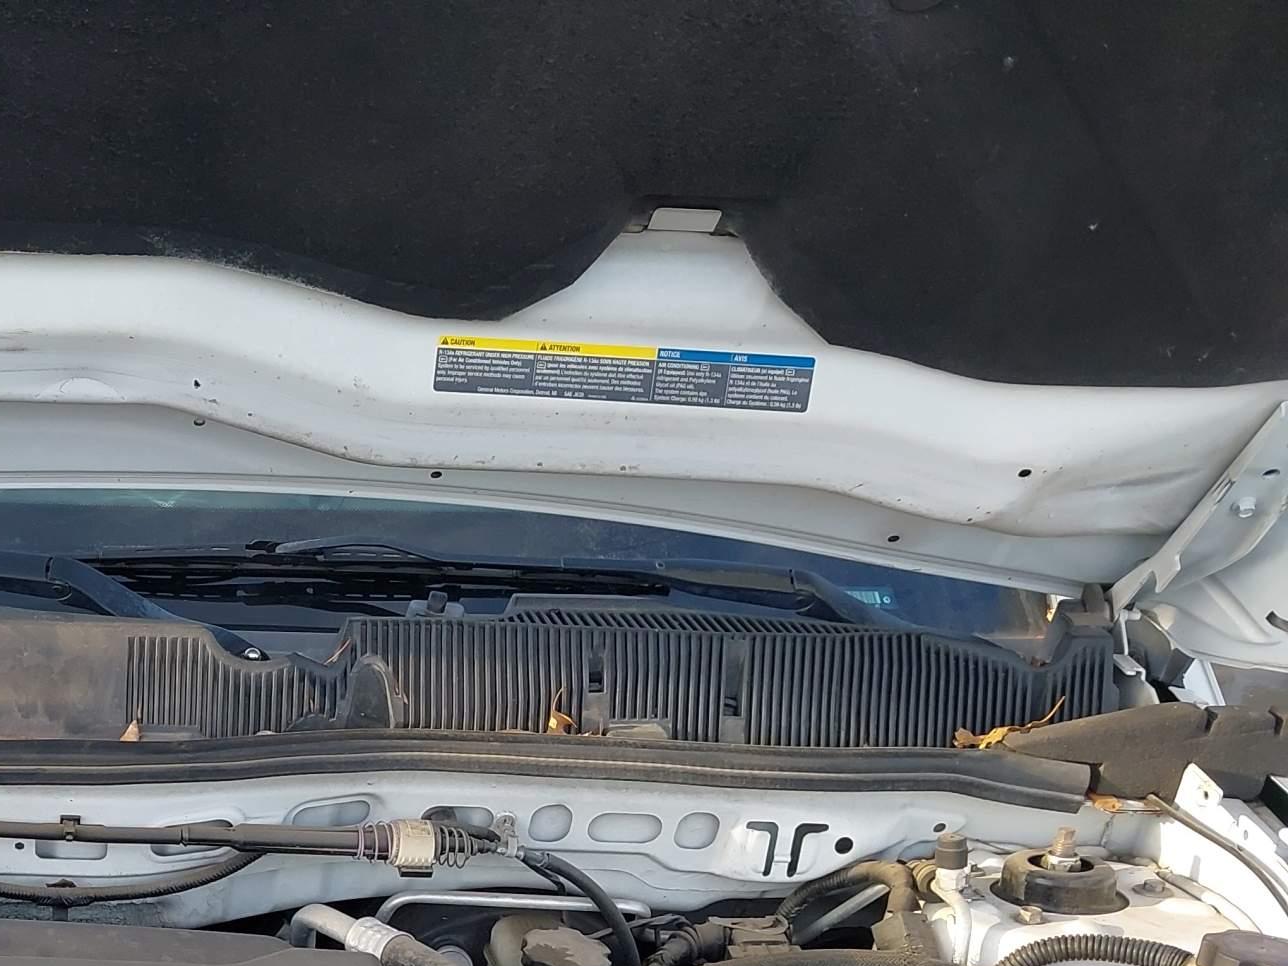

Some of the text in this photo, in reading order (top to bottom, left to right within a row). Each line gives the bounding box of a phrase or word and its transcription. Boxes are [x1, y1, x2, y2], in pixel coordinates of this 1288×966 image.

[450, 338, 475, 346] CAUTION
[548, 345, 580, 353] ATTENTION
[660, 350, 680, 358] NOTICE
